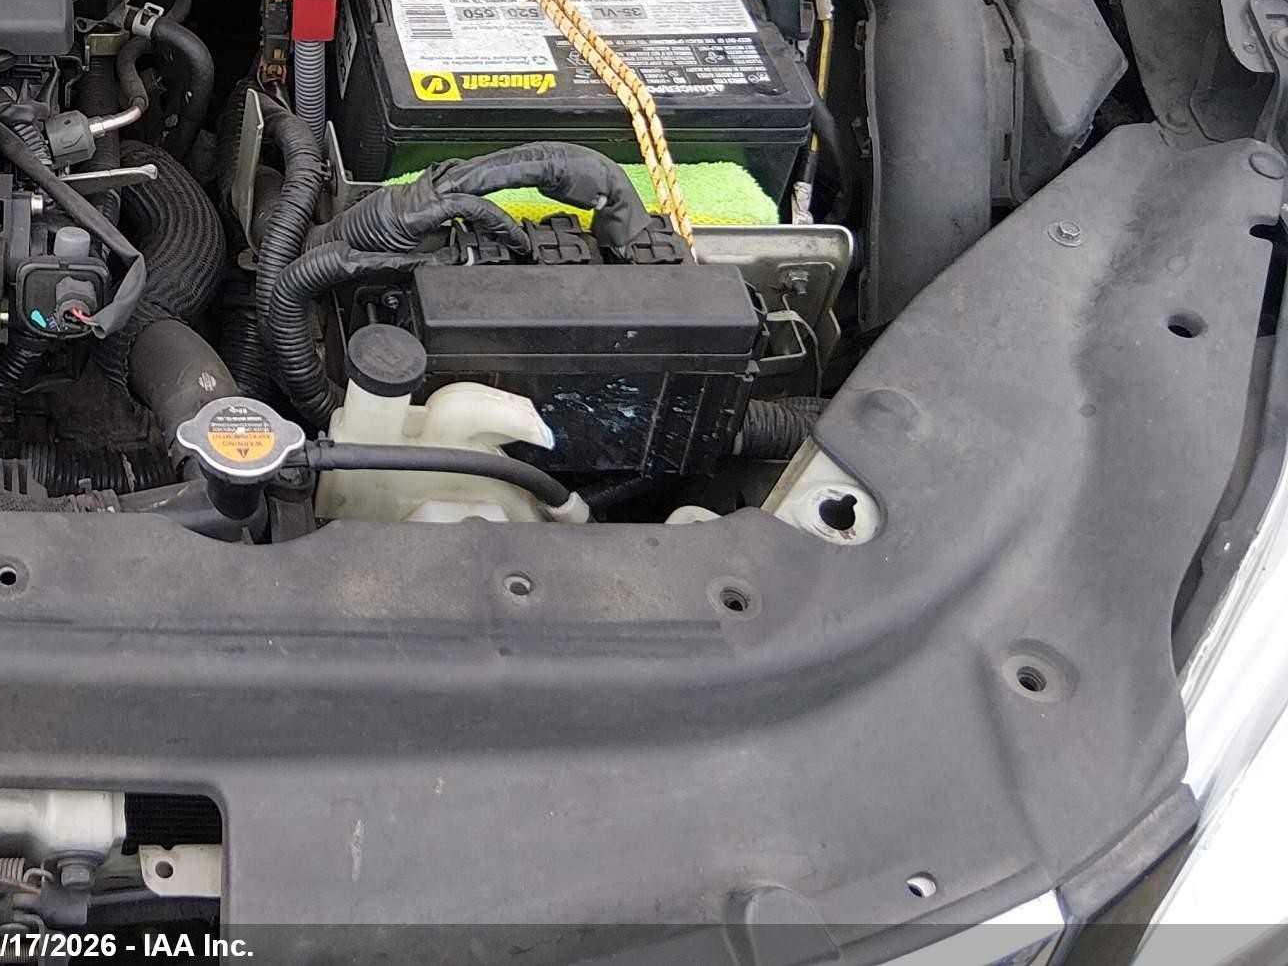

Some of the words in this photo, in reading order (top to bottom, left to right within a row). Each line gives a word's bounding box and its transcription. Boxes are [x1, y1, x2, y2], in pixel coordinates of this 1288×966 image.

[507, 8, 539, 18] 520
[593, 7, 642, 17] 35-VL
[461, 73, 557, 95] Valucraft
[646, 84, 715, 93] DANGER/PO
